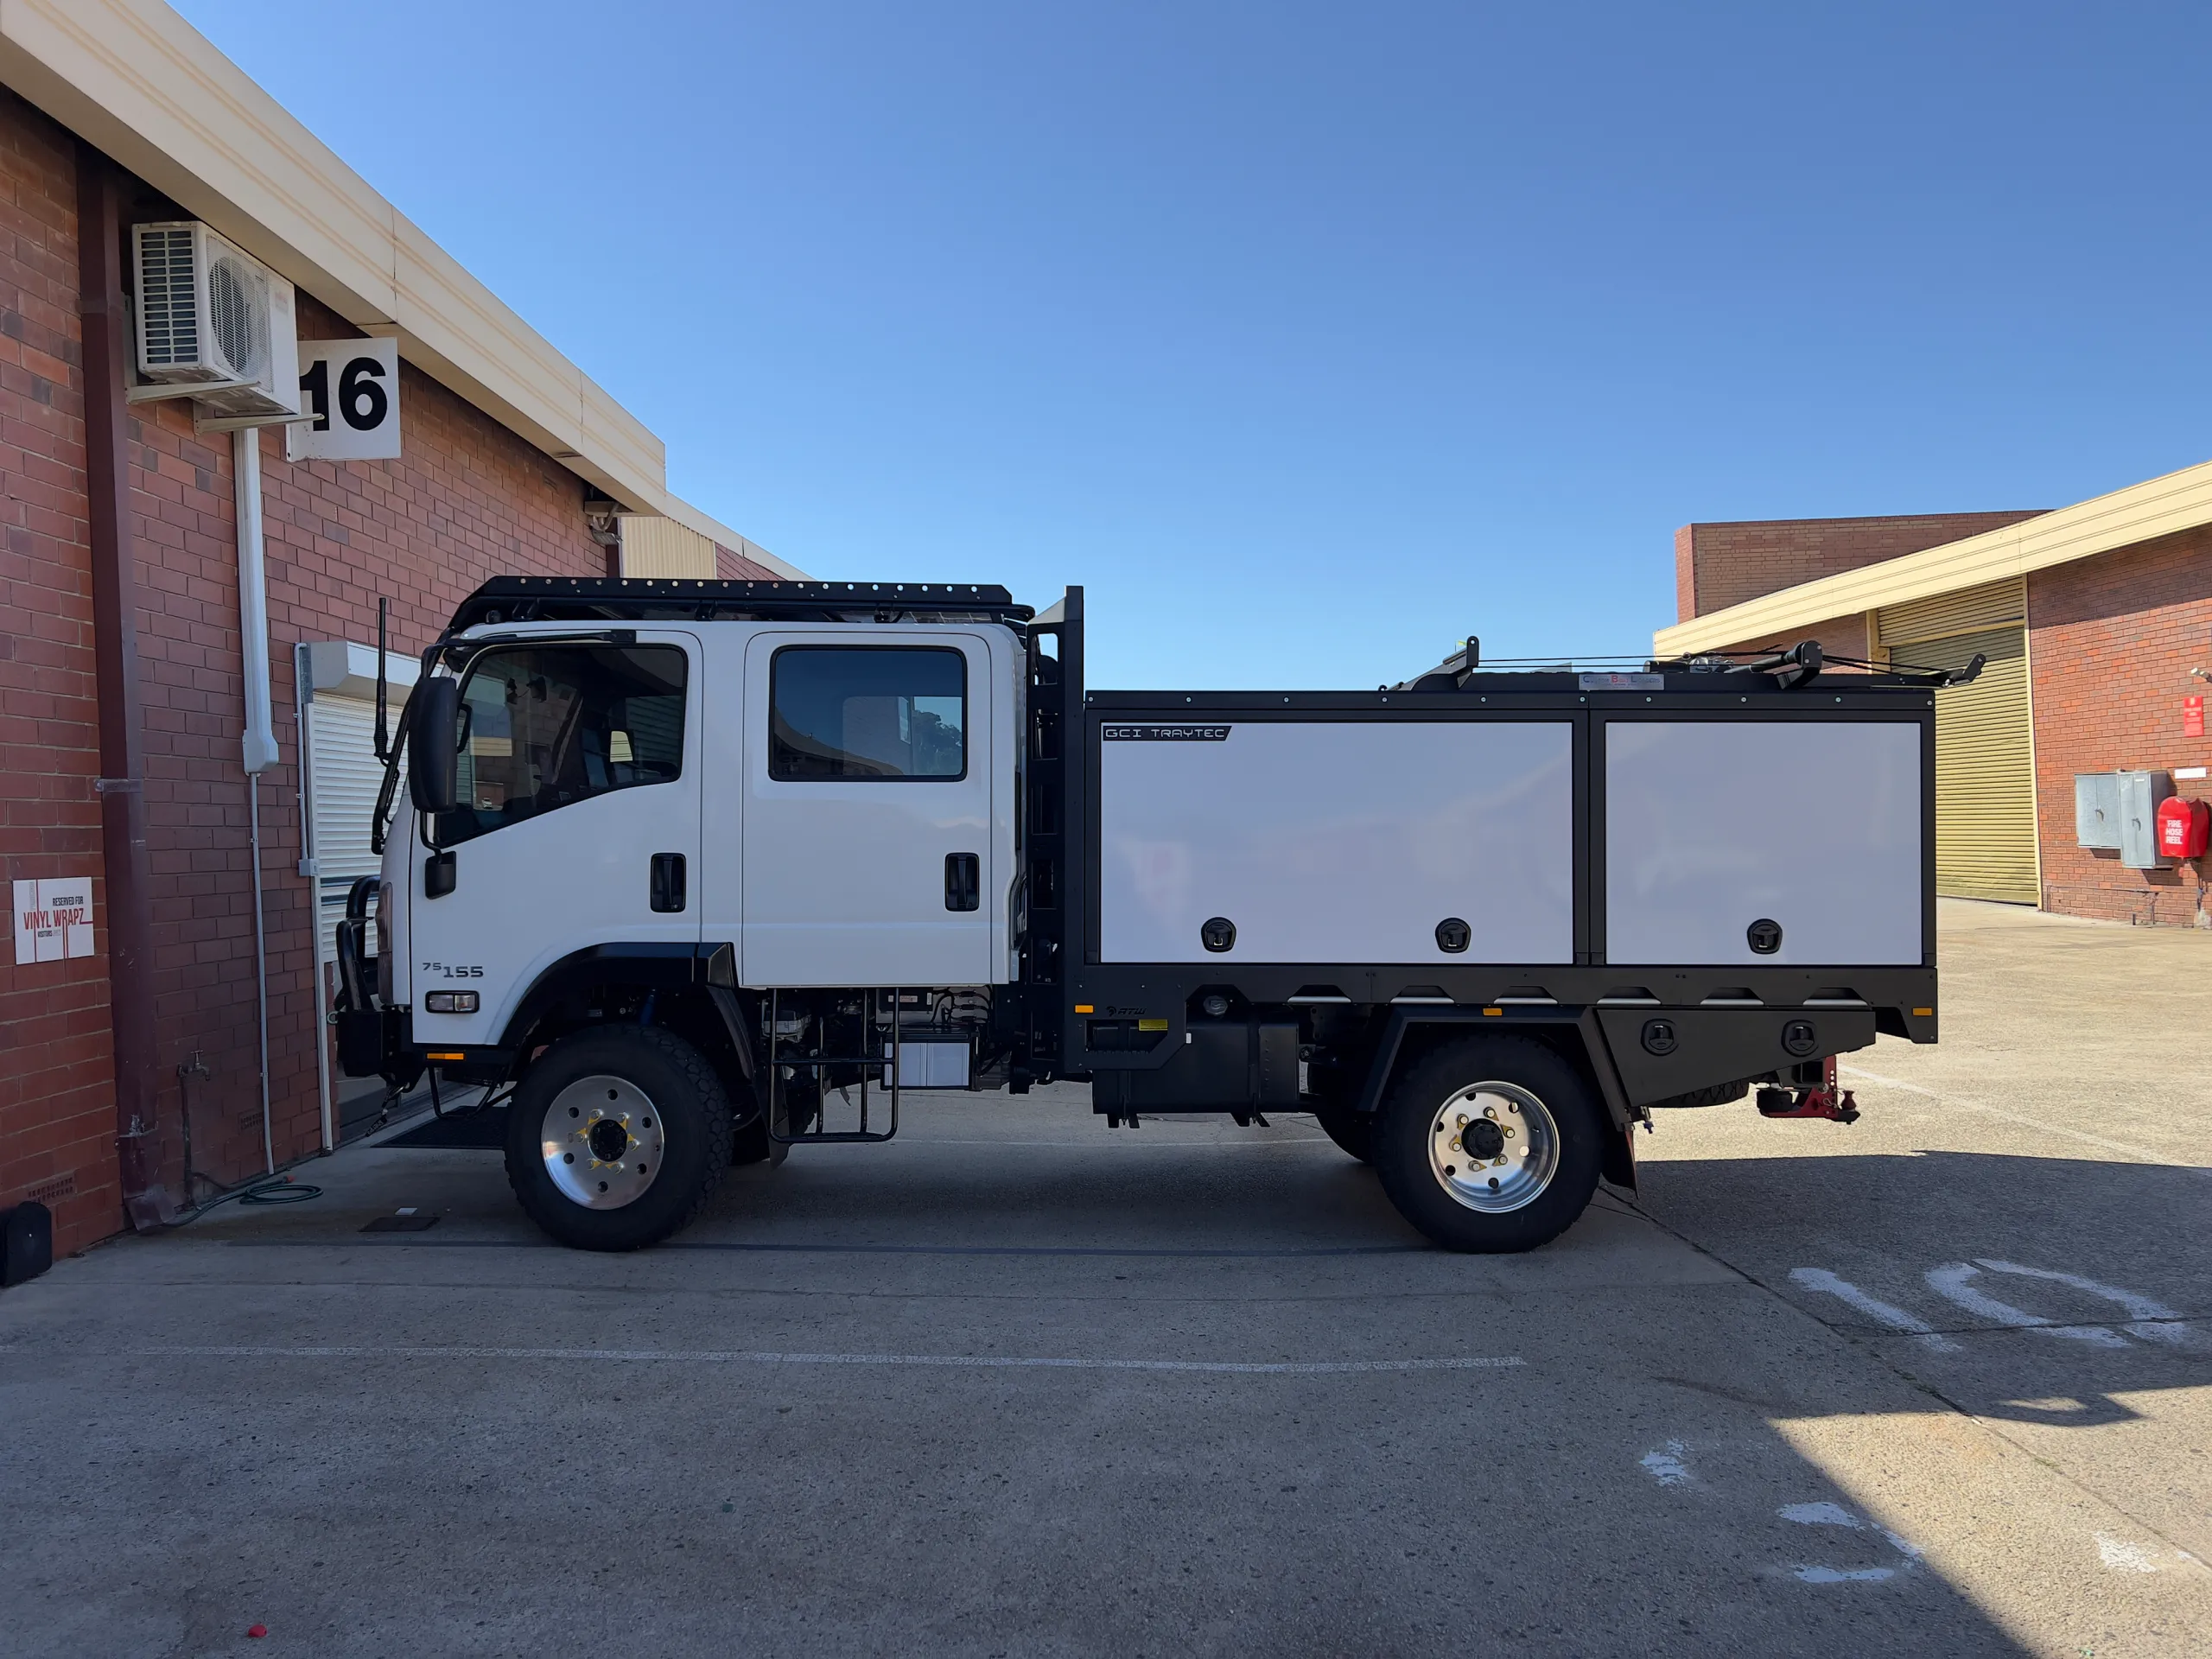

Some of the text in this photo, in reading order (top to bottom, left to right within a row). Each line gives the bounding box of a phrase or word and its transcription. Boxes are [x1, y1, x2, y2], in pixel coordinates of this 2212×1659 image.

[299, 356, 388, 431] 16
[1105, 728, 1224, 738] GCI TRAYTEC
[2166, 819, 2183, 828] FIRE
[2165, 827, 2183, 836] HOSE
[2165, 836, 2183, 844] REEL
[53, 896, 84, 906] RESERVED FOR
[23, 908, 84, 930] VINYL WRAPZ
[443, 966, 484, 978] 155
